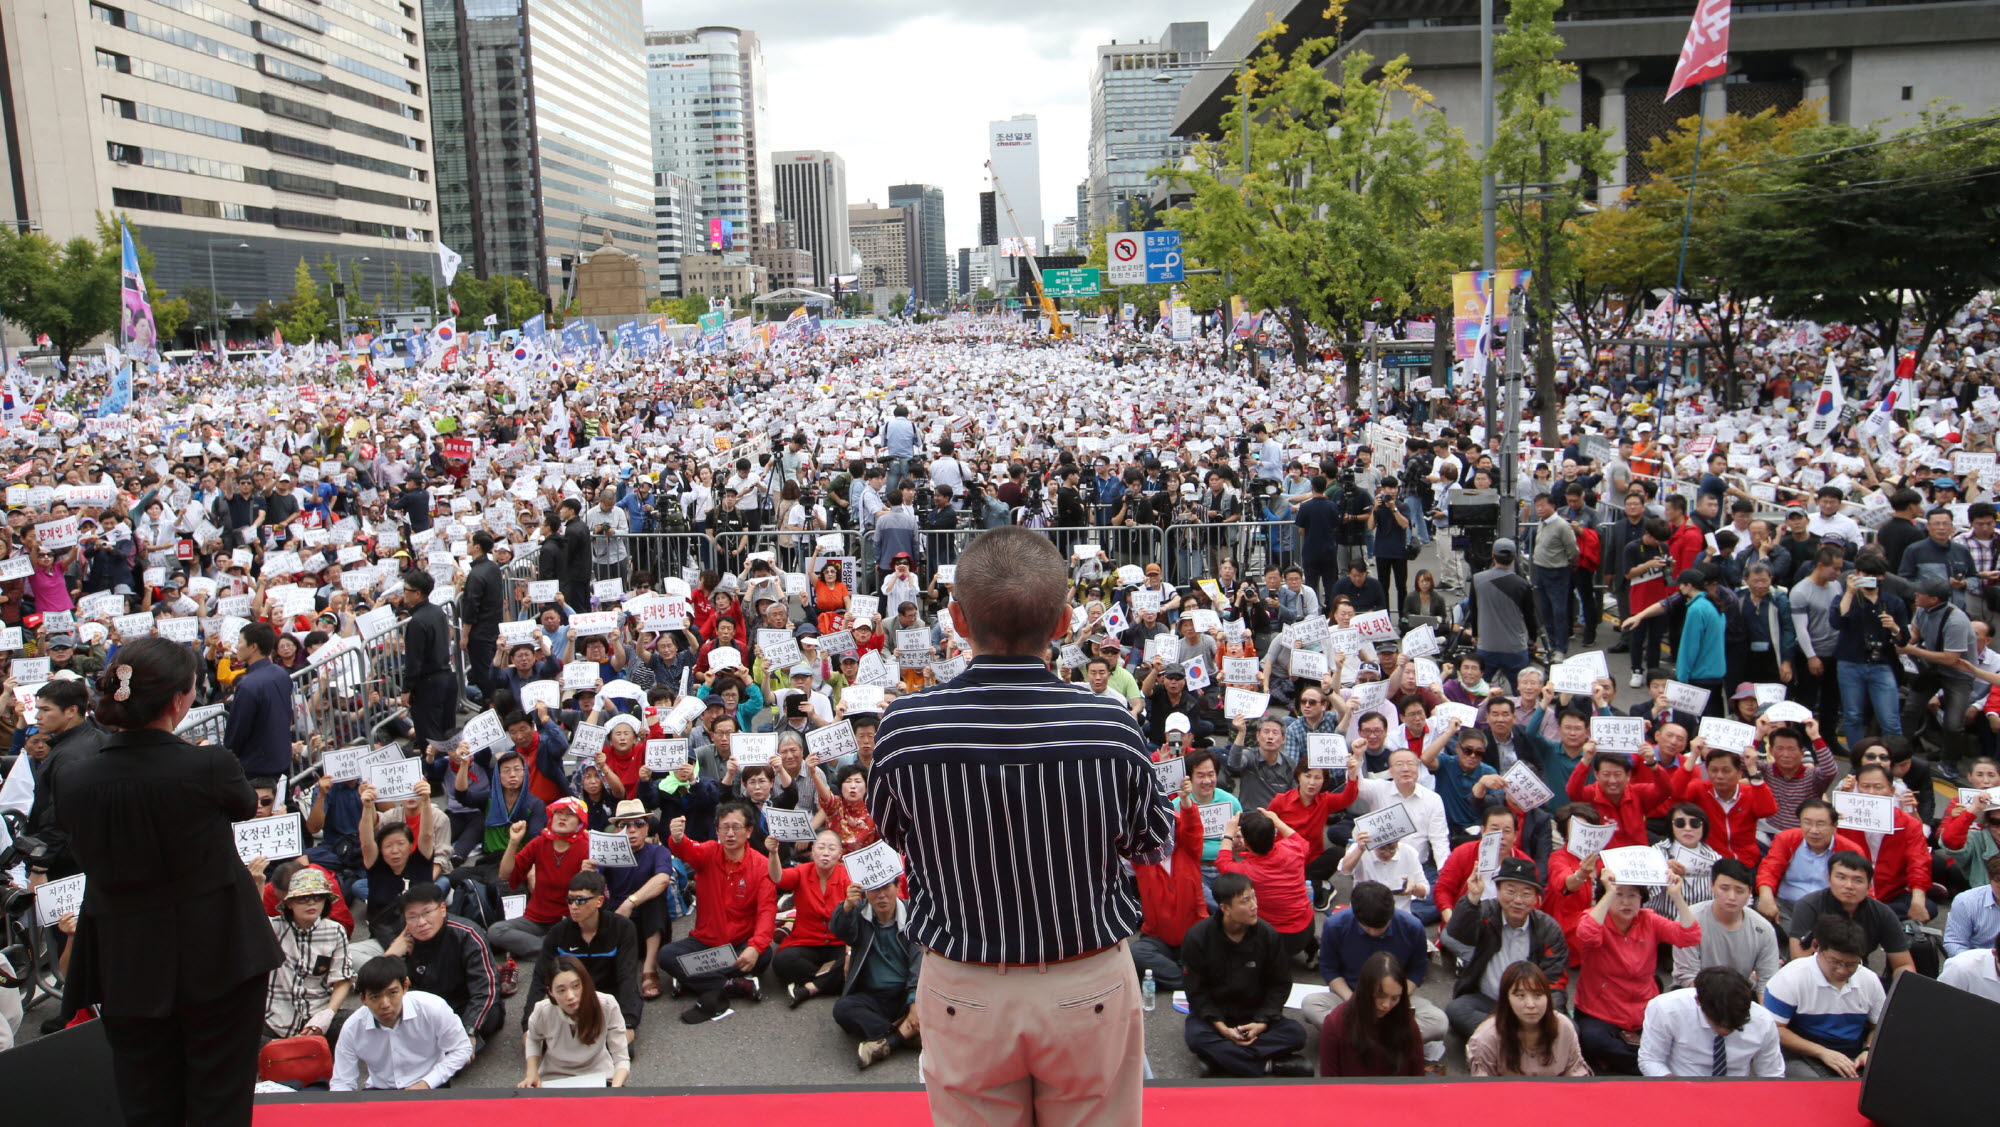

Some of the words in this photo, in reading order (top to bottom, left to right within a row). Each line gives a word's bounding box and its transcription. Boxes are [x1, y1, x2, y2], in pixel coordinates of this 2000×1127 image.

[996, 132, 1032, 141] 조선일보
[39, 526, 63, 541] 문재인
[643, 603, 666, 620] 문재인
[669, 602, 685, 618] 퇴진
[1374, 616, 1392, 634] 퇴진
[766, 648, 783, 657] 文정권
[785, 643, 796, 652] 심판
[1229, 674, 1253, 682] 대한민국
[480, 717, 496, 730] 심판
[1596, 722, 1621, 734] 文정권
[1624, 721, 1640, 734] 심판
[1706, 722, 1730, 733] 文정권
[1733, 726, 1750, 737] 심판
[484, 729, 501, 742] 구속
[576, 728, 593, 739] 文정권
[812, 733, 832, 747] 文정권
[833, 726, 850, 739] 심판
[573, 740, 589, 750] 조국
[742, 737, 767, 745] 지키자!
[1596, 737, 1616, 748] 조국
[1620, 736, 1640, 748] 구속
[647, 745, 667, 756] 文정권
[669, 744, 685, 755] 심판
[748, 744, 761, 752] 자유
[815, 747, 832, 759] 조국
[838, 741, 854, 754] 구속
[334, 751, 359, 760] 지키자!
[364, 751, 390, 765] 지키자!
[739, 752, 769, 762] 대한민국
[1316, 756, 1344, 764] 대한민국
[341, 759, 355, 768] 자유
[646, 757, 662, 768] 조국
[667, 756, 686, 767] 구속
[380, 765, 408, 776] 지키자!
[386, 775, 402, 785] 자유
[1512, 769, 1536, 790] 文정권
[1532, 786, 1546, 801] 심판
[379, 783, 414, 796] 대한민국
[1520, 793, 1534, 807] 구속
[1848, 798, 1880, 808] 지키자!
[1199, 807, 1223, 818] 지키자!
[1855, 808, 1873, 817] 자유
[770, 816, 791, 828] 文정권
[791, 816, 808, 829] 심판
[1203, 817, 1219, 826] 자유
[1367, 812, 1395, 827] 지키자!
[1844, 816, 1882, 829] 대한민국
[239, 827, 270, 843] 文정권
[274, 821, 297, 836] 심판
[1204, 824, 1226, 835] 한민국
[1378, 822, 1394, 834] 자유
[1580, 828, 1607, 840] 지키자!
[770, 830, 788, 839] 조국
[791, 830, 812, 839] 구속
[1373, 828, 1406, 845] 대한민국
[239, 843, 264, 857] 조국
[271, 838, 297, 852] 구속
[590, 839, 610, 853] 文정권
[610, 839, 628, 852] 심판
[1585, 839, 1600, 849] 자유
[612, 853, 632, 865] 구속
[857, 846, 886, 865] 지키자!
[1619, 849, 1650, 858] 지키자!
[865, 858, 885, 874] 자유
[1628, 858, 1647, 869] 자유
[861, 865, 896, 888] 대한민국
[1621, 867, 1661, 880] 대한민국
[49, 880, 82, 896] 지키자!
[55, 892, 75, 905] 자유
[691, 950, 721, 962] 지키자!
[701, 956, 721, 966] 자유
[694, 961, 731, 974] 대한민국
